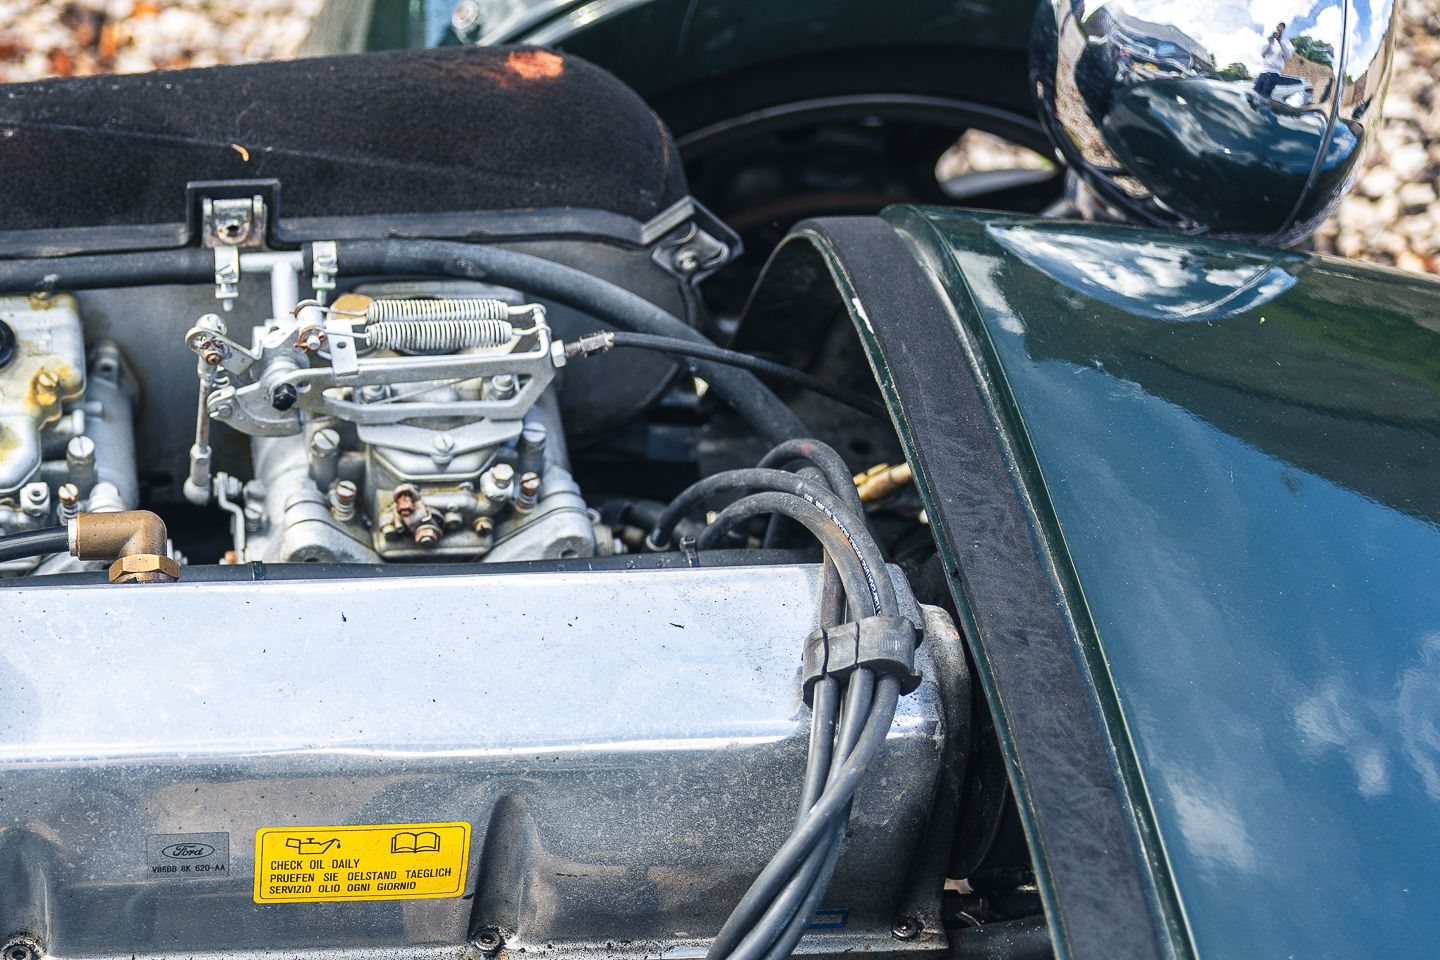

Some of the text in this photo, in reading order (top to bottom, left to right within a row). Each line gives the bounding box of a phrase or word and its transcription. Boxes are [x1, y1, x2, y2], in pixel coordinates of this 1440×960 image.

[172, 845, 204, 857] Ford
[270, 858, 360, 871] CHECK OIL DAILY
[269, 867, 452, 883] PRUEFEN SIE OELSTAND TAEGLICH
[269, 881, 417, 895] SERVIZIO OLIO OGNI GIORNIO
